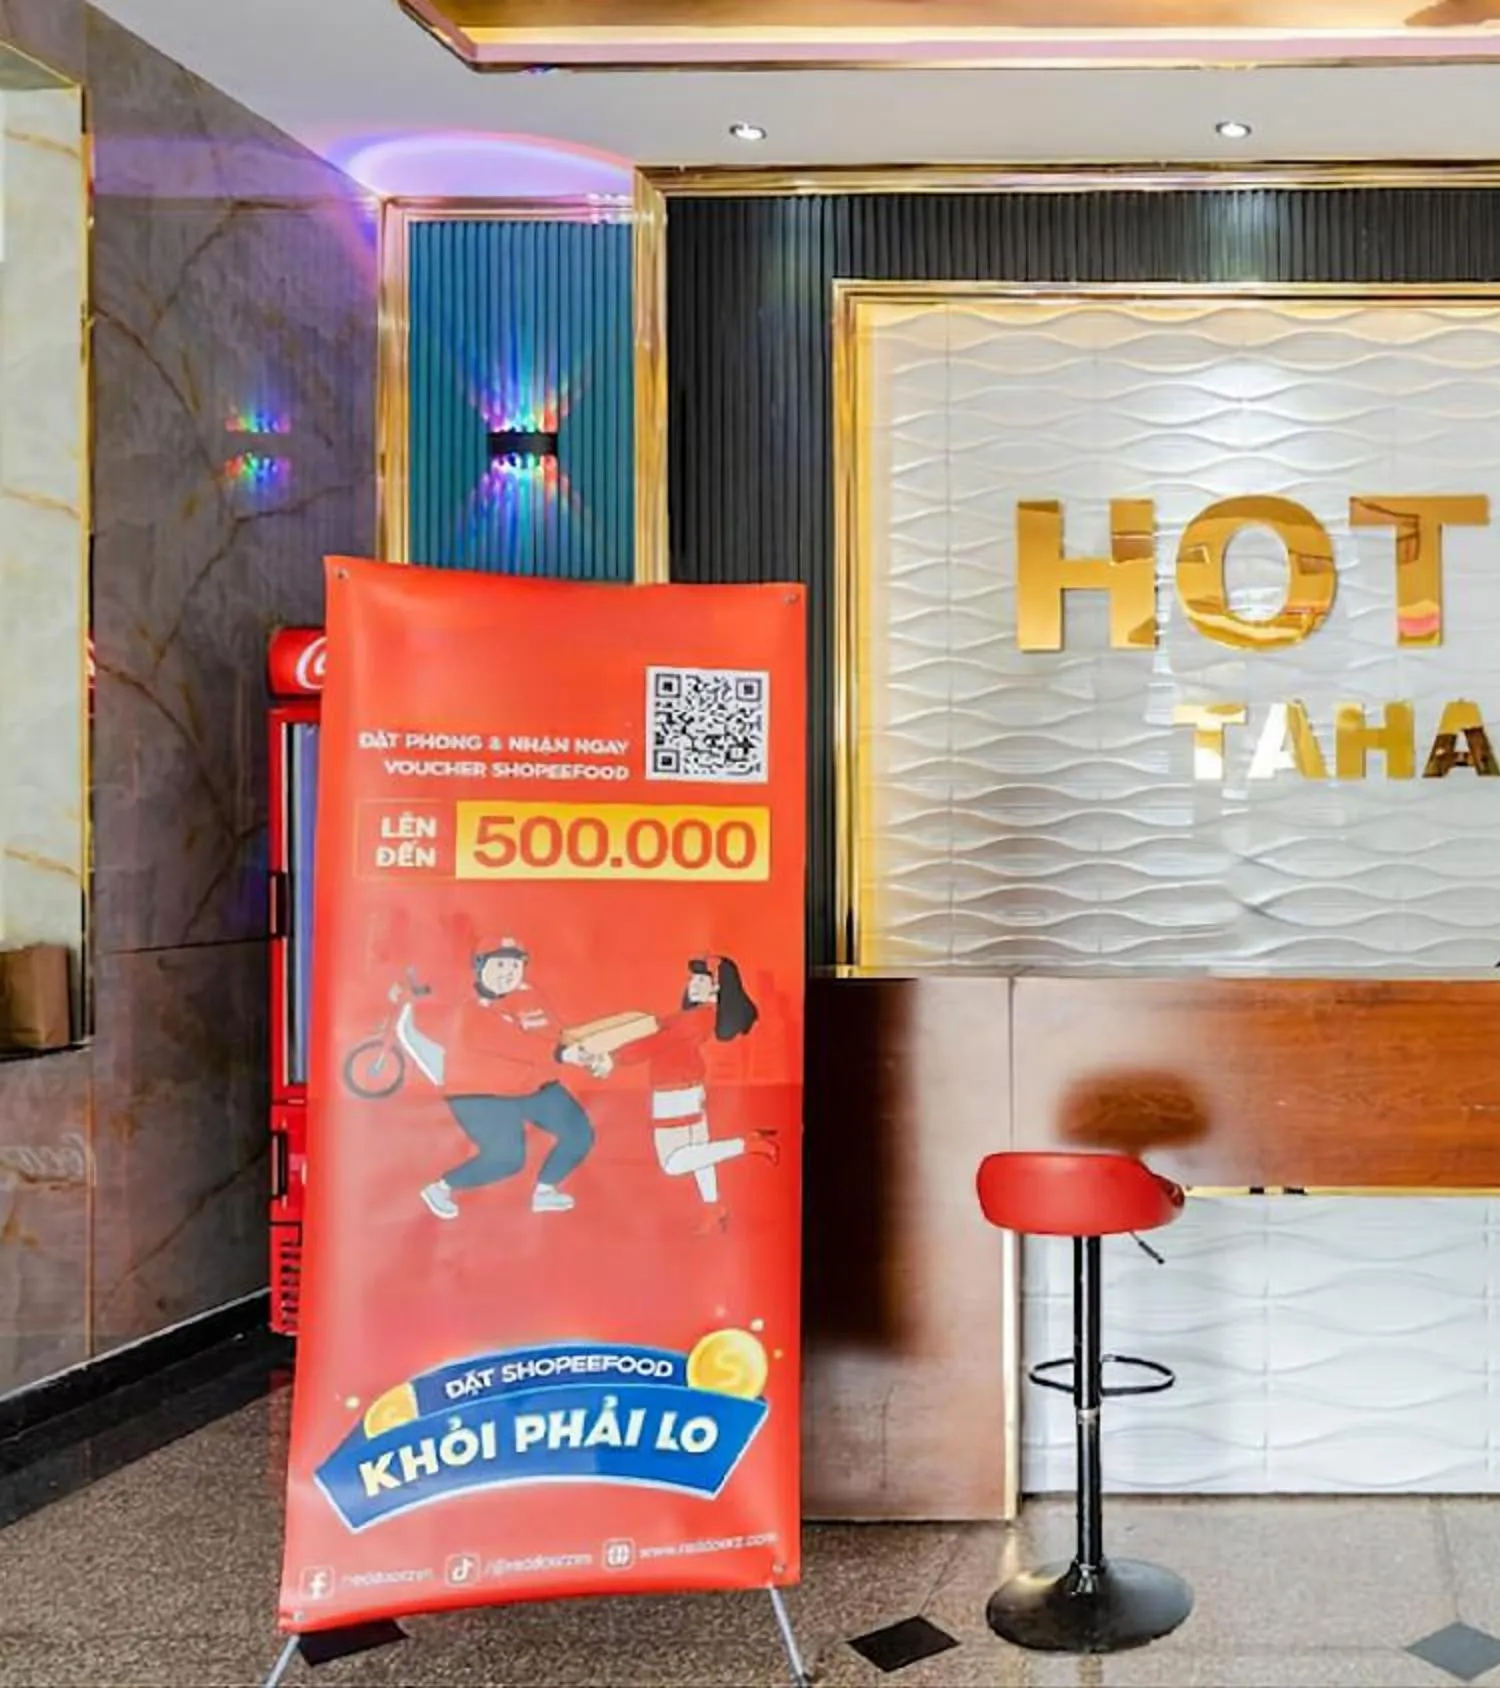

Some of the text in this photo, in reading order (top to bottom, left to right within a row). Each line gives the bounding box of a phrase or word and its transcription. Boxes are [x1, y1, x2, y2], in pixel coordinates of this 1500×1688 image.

[384, 759, 630, 781] VOUCHER SHOPEEFOOD
[381, 810, 437, 838] LÊN
[376, 840, 437, 867] ĐẾN
[473, 815, 757, 869] 500.000
[502, 1354, 673, 1385] SHOPEEFOOD
[359, 1396, 719, 1497] KHỎI PHẢI LO
